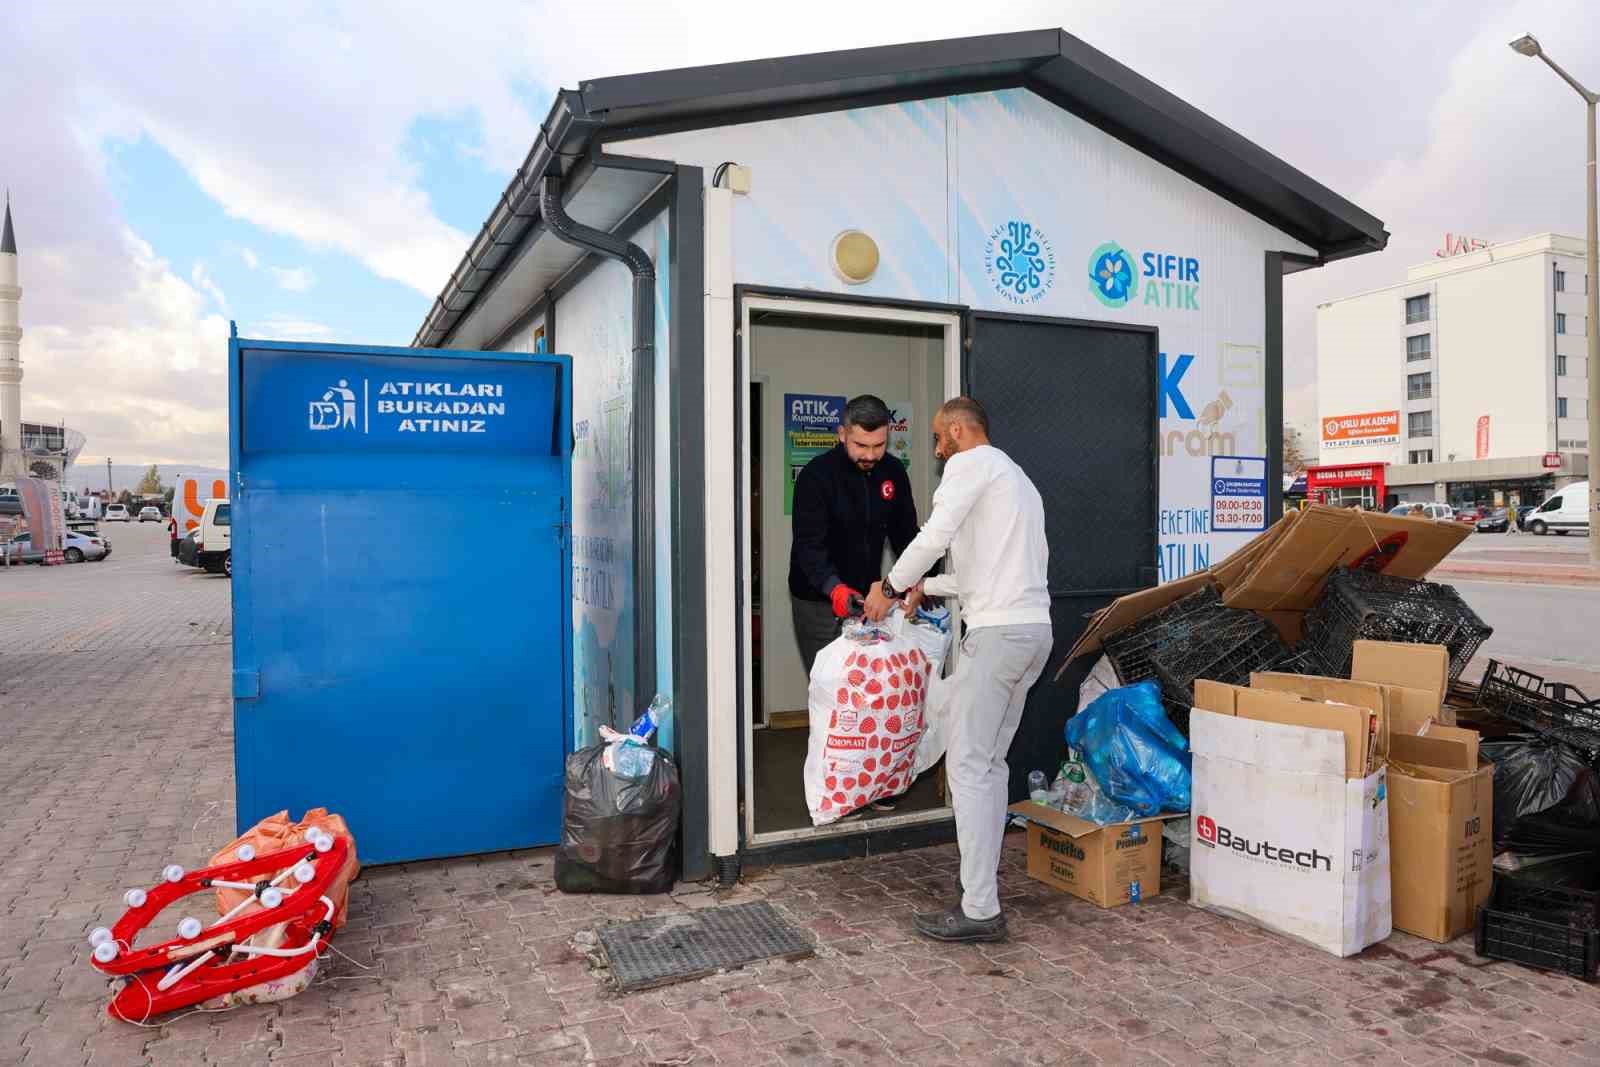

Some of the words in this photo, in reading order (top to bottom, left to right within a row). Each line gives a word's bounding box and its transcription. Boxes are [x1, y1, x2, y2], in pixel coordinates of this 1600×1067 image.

[1142, 252, 1200, 283] SIFIR
[1143, 280, 1200, 310] ATIK
[379, 381, 503, 397] ATIKLARI
[377, 400, 505, 416] BURADAN
[792, 400, 830, 415] ATIK
[398, 419, 486, 433] ATINIZ
[1340, 418, 1360, 428] USLU
[1360, 413, 1397, 426] AKADEMİ
[1215, 500, 1262, 510] 09.00-12.30
[1215, 513, 1263, 523] 13.30-17.00
[1217, 825, 1332, 871] Bautech
